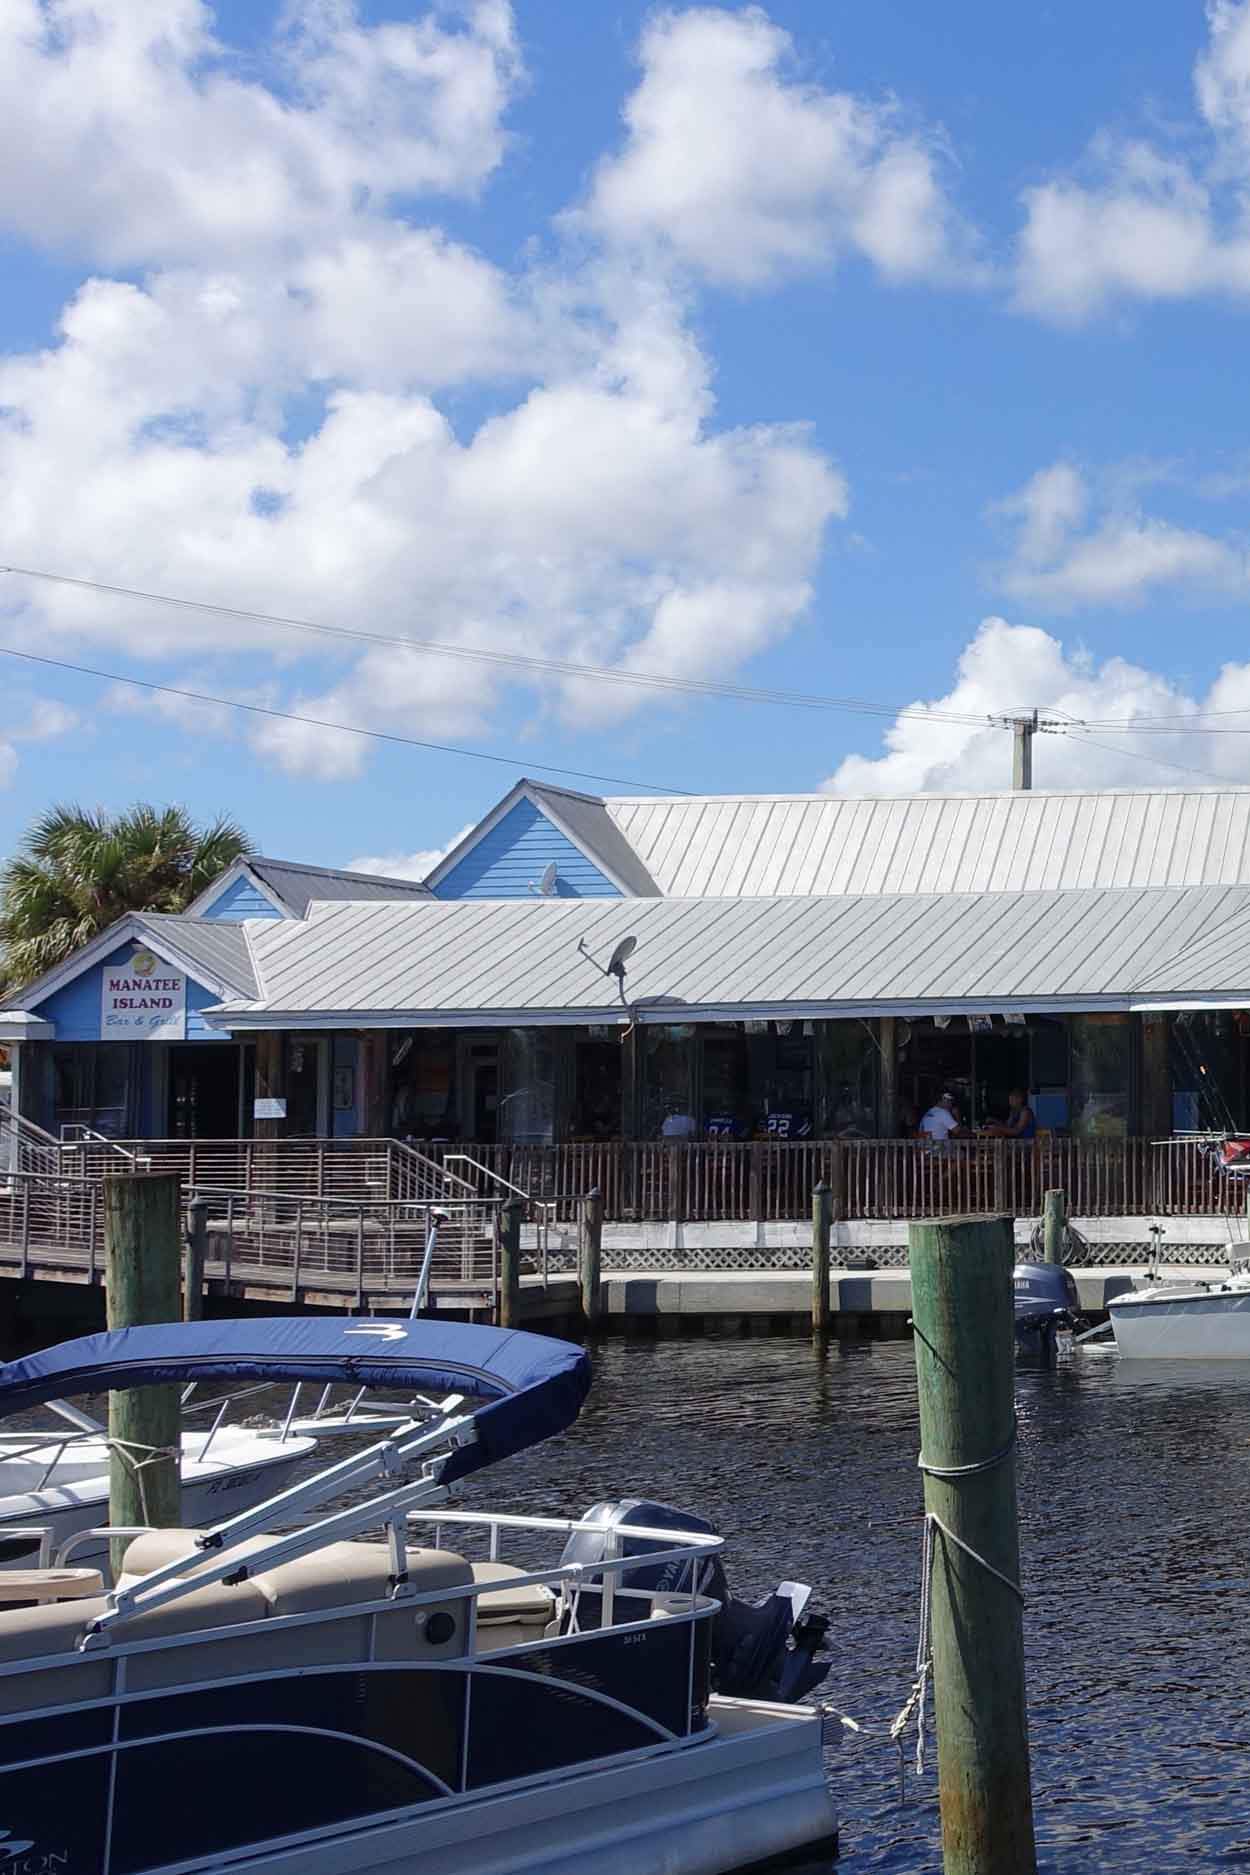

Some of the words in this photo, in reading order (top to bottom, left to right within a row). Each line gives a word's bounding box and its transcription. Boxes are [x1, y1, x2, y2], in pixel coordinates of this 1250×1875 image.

[109, 979, 181, 991] MANATEE
[112, 998, 173, 1009] ISLAND
[105, 1015, 128, 1026] Bar
[134, 1015, 145, 1026] &
[767, 1120, 790, 1138] 22
